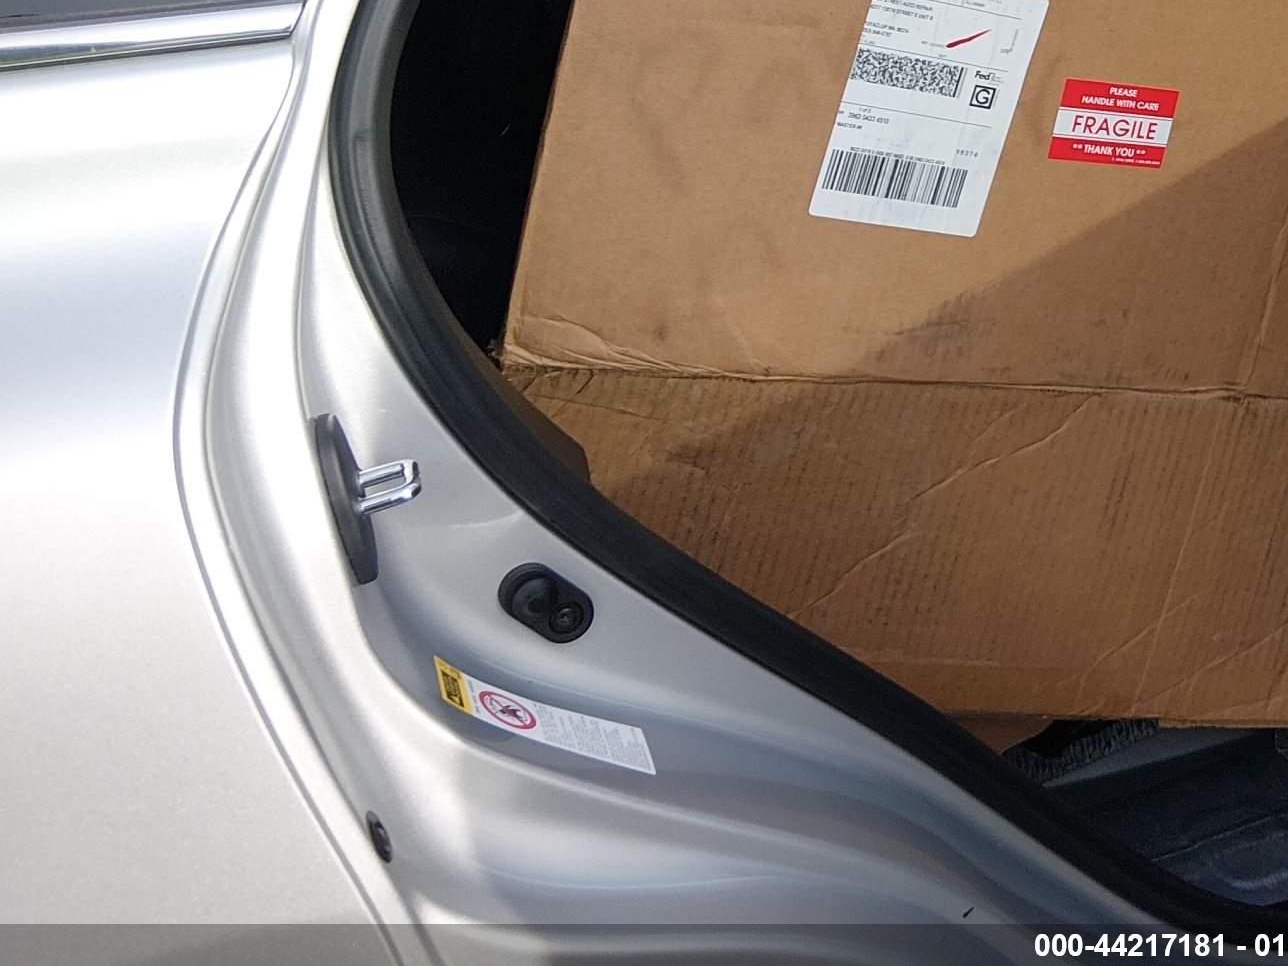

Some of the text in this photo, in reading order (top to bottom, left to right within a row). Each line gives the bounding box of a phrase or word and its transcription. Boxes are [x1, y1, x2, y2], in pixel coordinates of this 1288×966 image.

[975, 88, 991, 105] G
[1109, 87, 1138, 97] PLEASE
[1081, 95, 1159, 111] HANDLE WITH CARE
[1072, 114, 1158, 140] FRAGILE
[1083, 143, 1135, 157] THANK YOU
